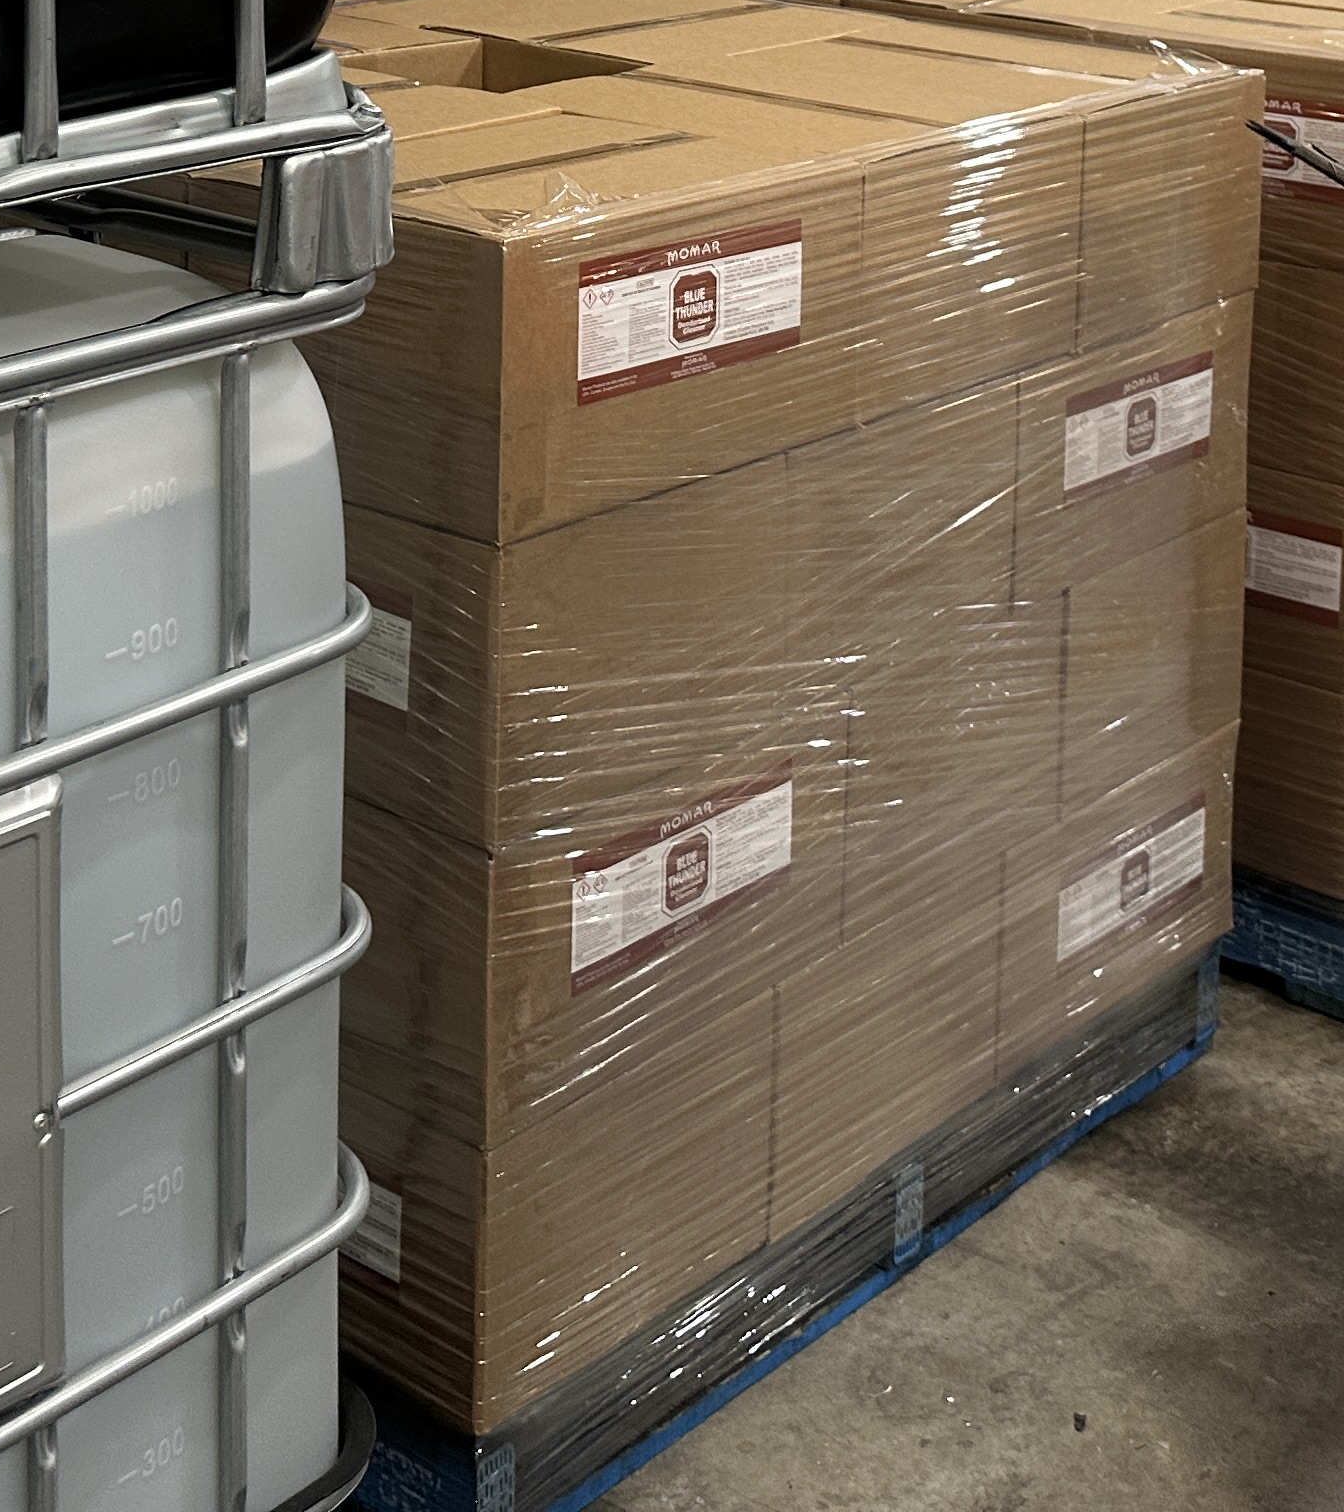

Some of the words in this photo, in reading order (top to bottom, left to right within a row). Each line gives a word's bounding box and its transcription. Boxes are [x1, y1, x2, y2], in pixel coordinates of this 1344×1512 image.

[666, 240, 721, 266] MOMAR
[675, 299, 714, 319] THUNDER
[684, 287, 705, 304] BLUE
[131, 617, 178, 661] 900
[134, 758, 180, 803] 800
[660, 800, 715, 839] MOMAR
[137, 896, 184, 944] 700
[141, 1166, 185, 1216] 500
[141, 1428, 187, 1477] 300
